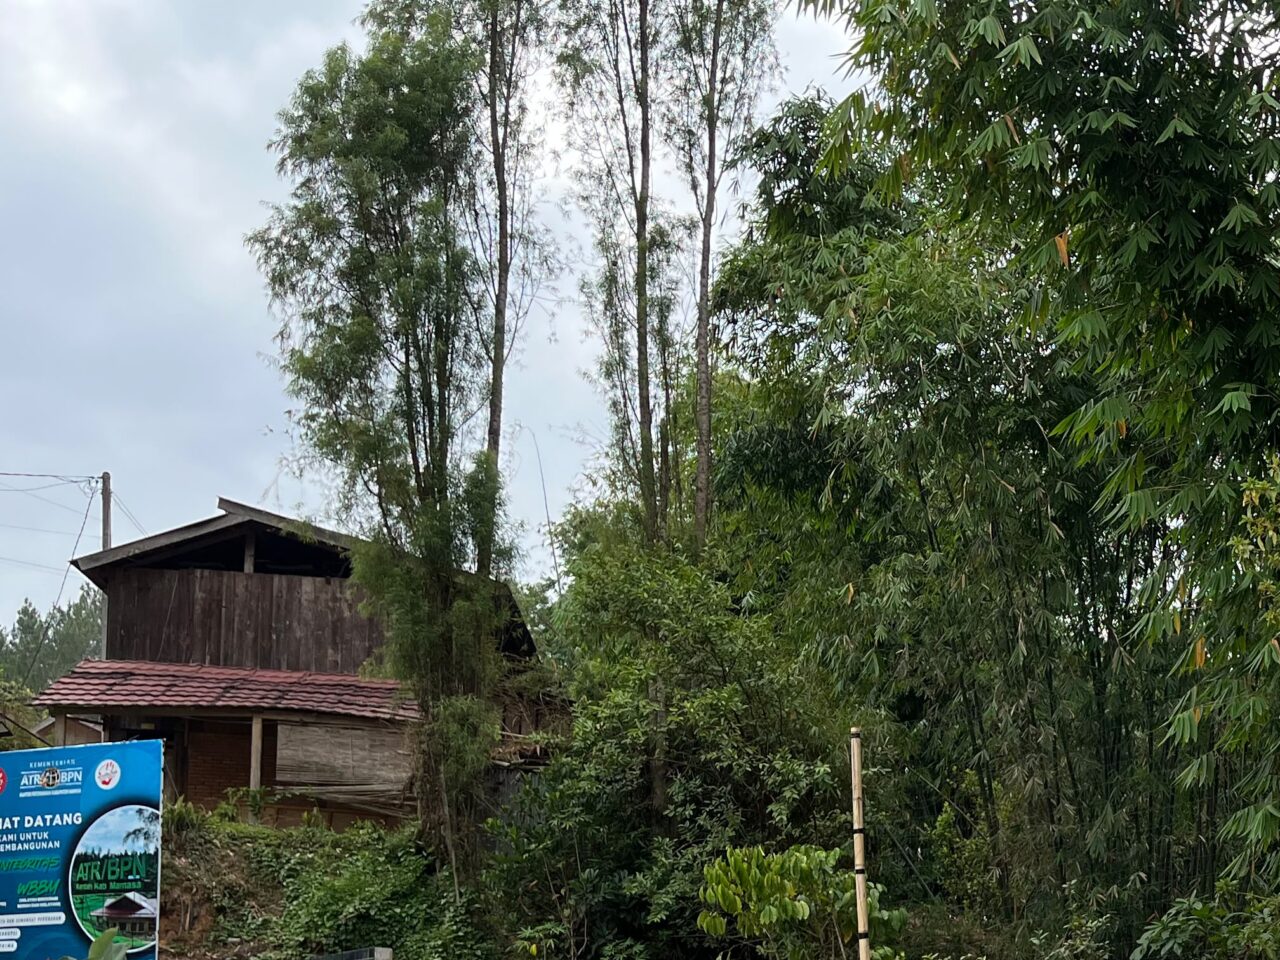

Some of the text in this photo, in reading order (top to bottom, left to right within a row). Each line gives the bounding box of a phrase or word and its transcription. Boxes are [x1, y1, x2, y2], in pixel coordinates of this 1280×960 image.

[20, 770, 83, 786] ATR BPN
[0, 812, 82, 830] AT DATANG
[19, 831, 49, 841] UNTUK
[76, 855, 146, 881] ATR/BPN
[17, 878, 61, 896] WBBM
